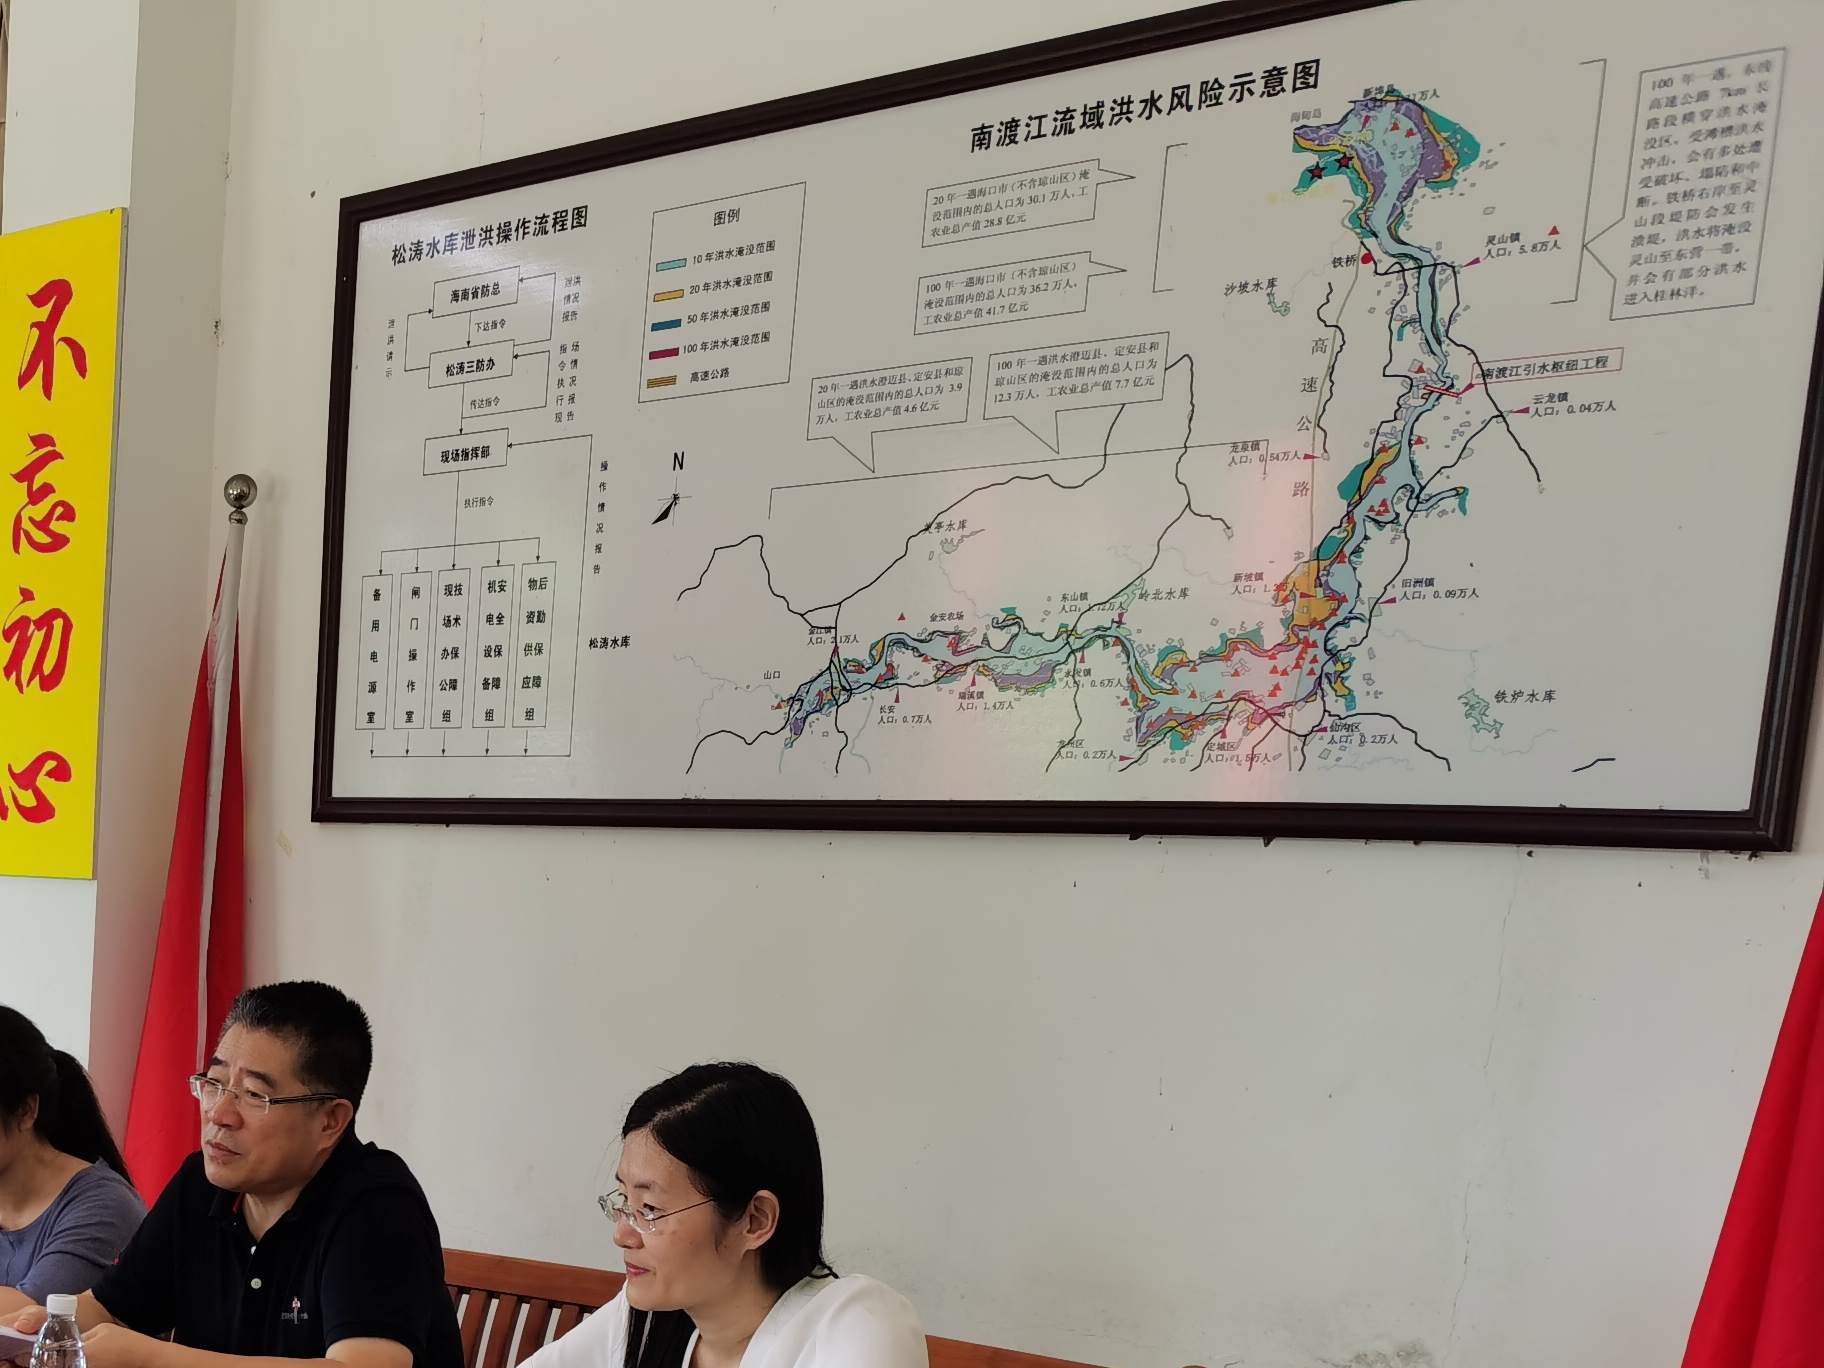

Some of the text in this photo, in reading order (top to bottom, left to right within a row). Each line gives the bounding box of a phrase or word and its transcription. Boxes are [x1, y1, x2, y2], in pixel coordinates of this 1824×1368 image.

[970, 58, 1320, 153] 南渡江流域洪水风险示意图
[713, 208, 741, 227] 图例
[391, 204, 588, 266] 松涛水库泄洪操作流程图
[1331, 253, 1357, 269] 铁桥
[450, 281, 501, 304] 海南省防总
[1223, 277, 1278, 297] 沙坡水库
[475, 318, 507, 333] 下达指令
[445, 356, 496, 378] 松涛三防办
[690, 367, 730, 383] 高速公路
[469, 395, 501, 410] 传达指令
[440, 444, 491, 464] 现场指挥部
[673, 451, 684, 471] N
[464, 495, 495, 509] 执行指令
[588, 635, 631, 651] 松涛水库
[879, 704, 896, 715] 长安
